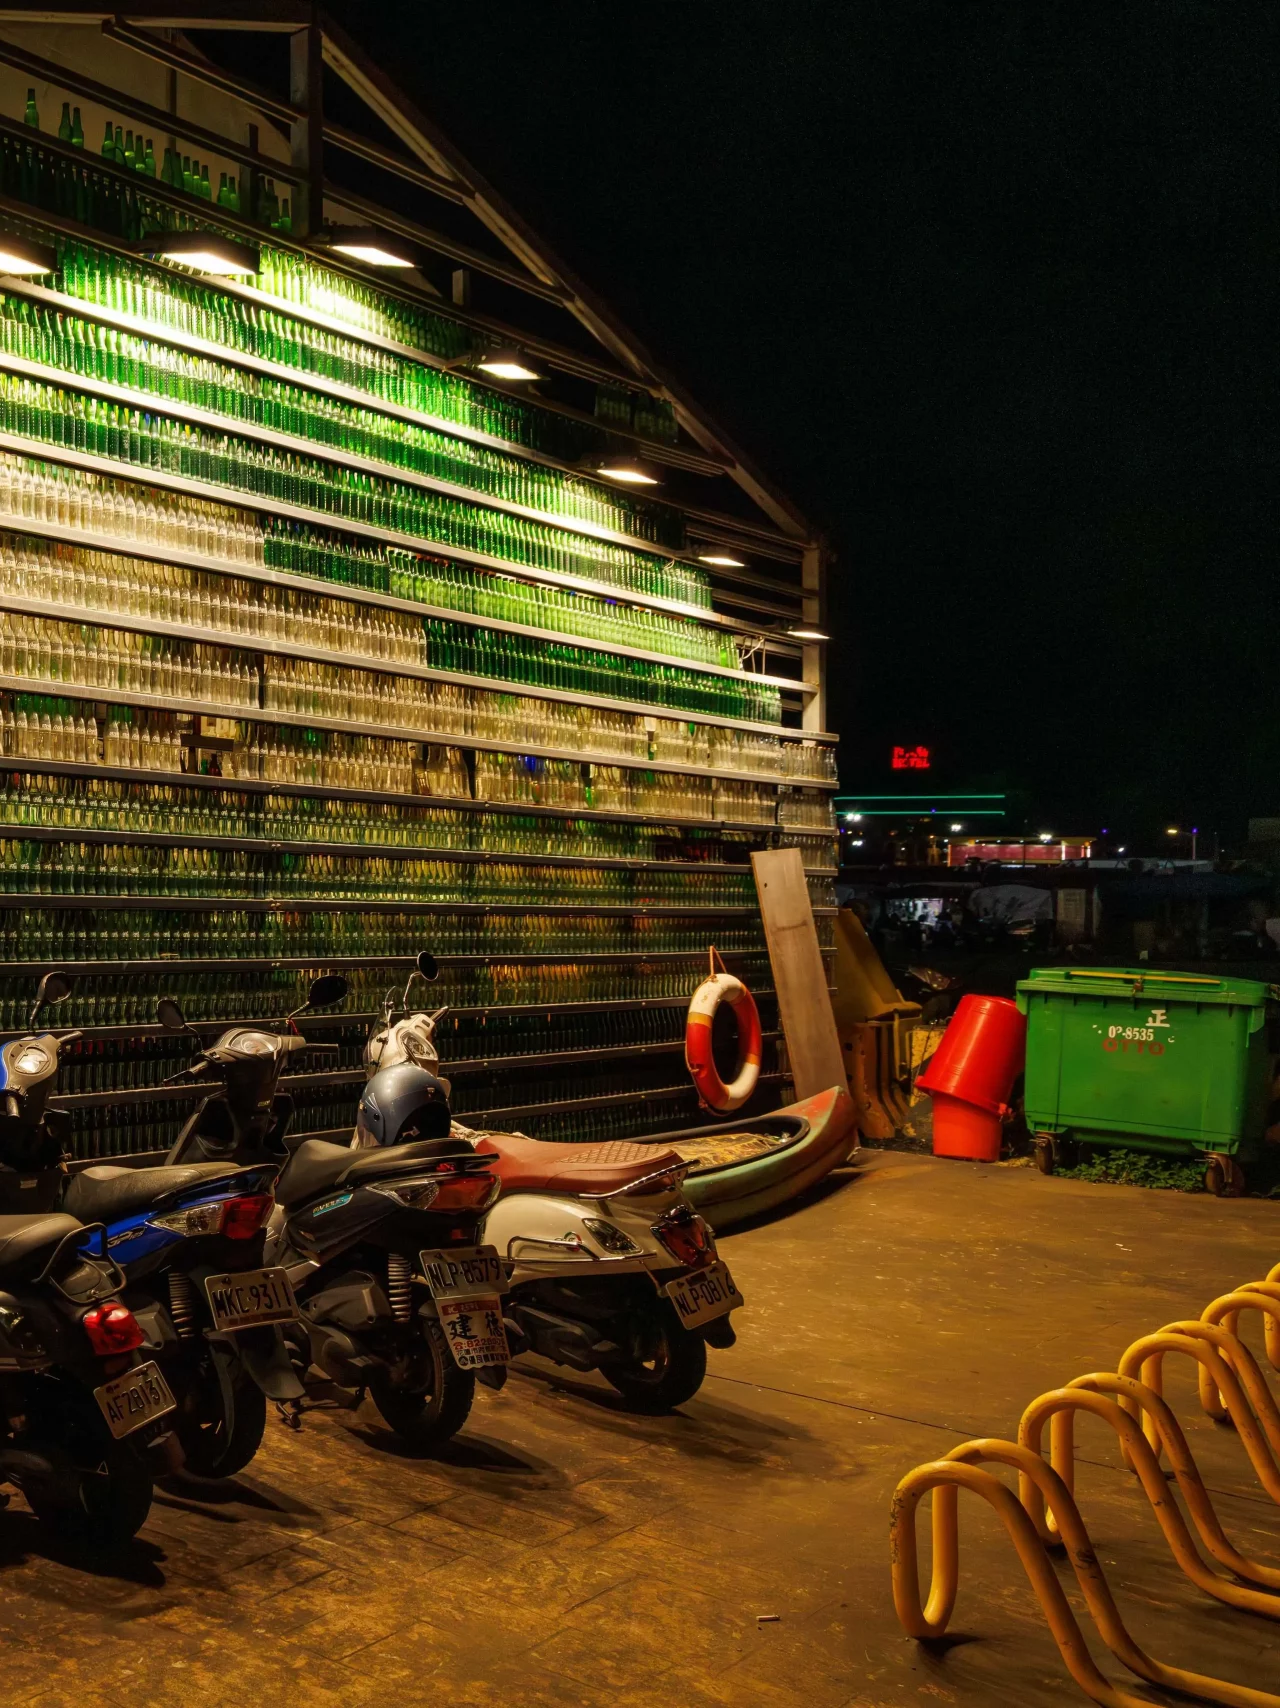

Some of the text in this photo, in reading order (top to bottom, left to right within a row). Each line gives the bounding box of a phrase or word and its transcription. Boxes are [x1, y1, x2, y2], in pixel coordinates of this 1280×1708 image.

[1102, 1038, 1165, 1056] OTTO
[426, 1257, 500, 1291] NLP-8579
[674, 1272, 736, 1318] NLP-0816
